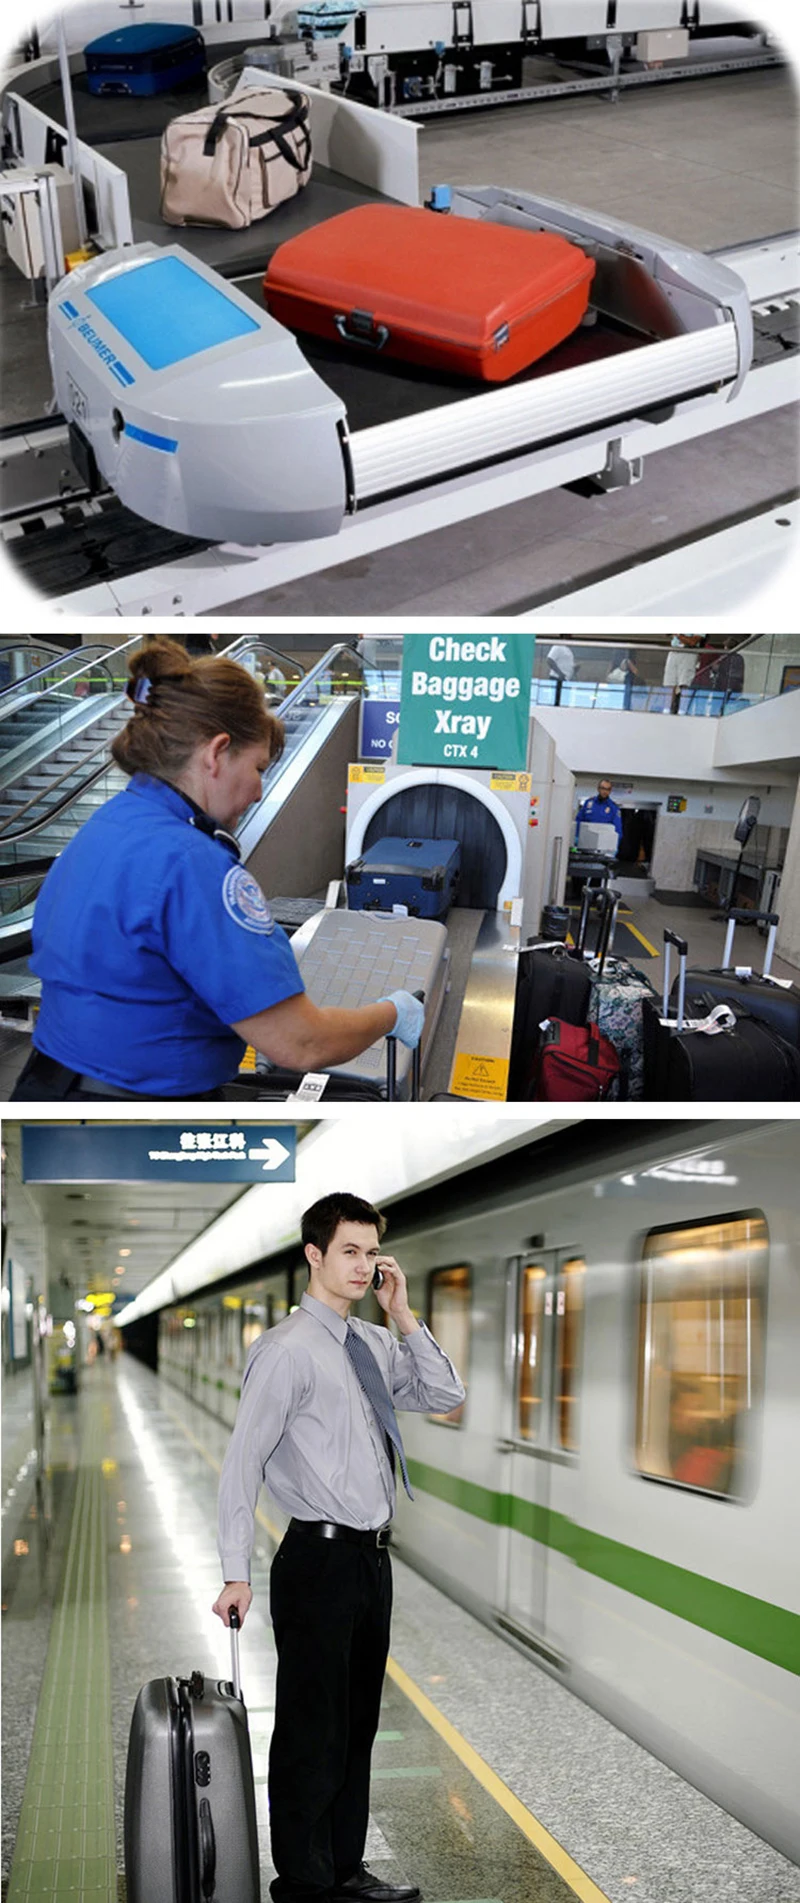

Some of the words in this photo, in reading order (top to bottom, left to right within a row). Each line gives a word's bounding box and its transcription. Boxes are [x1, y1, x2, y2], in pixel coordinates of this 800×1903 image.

[77, 323, 117, 365] BEUMER
[429, 636, 507, 662] Check
[411, 671, 521, 702] Baggage
[433, 710, 492, 740] Xray
[371, 739, 386, 749] NO
[443, 744, 467, 758] CTX
[470, 745, 479, 758] 4
